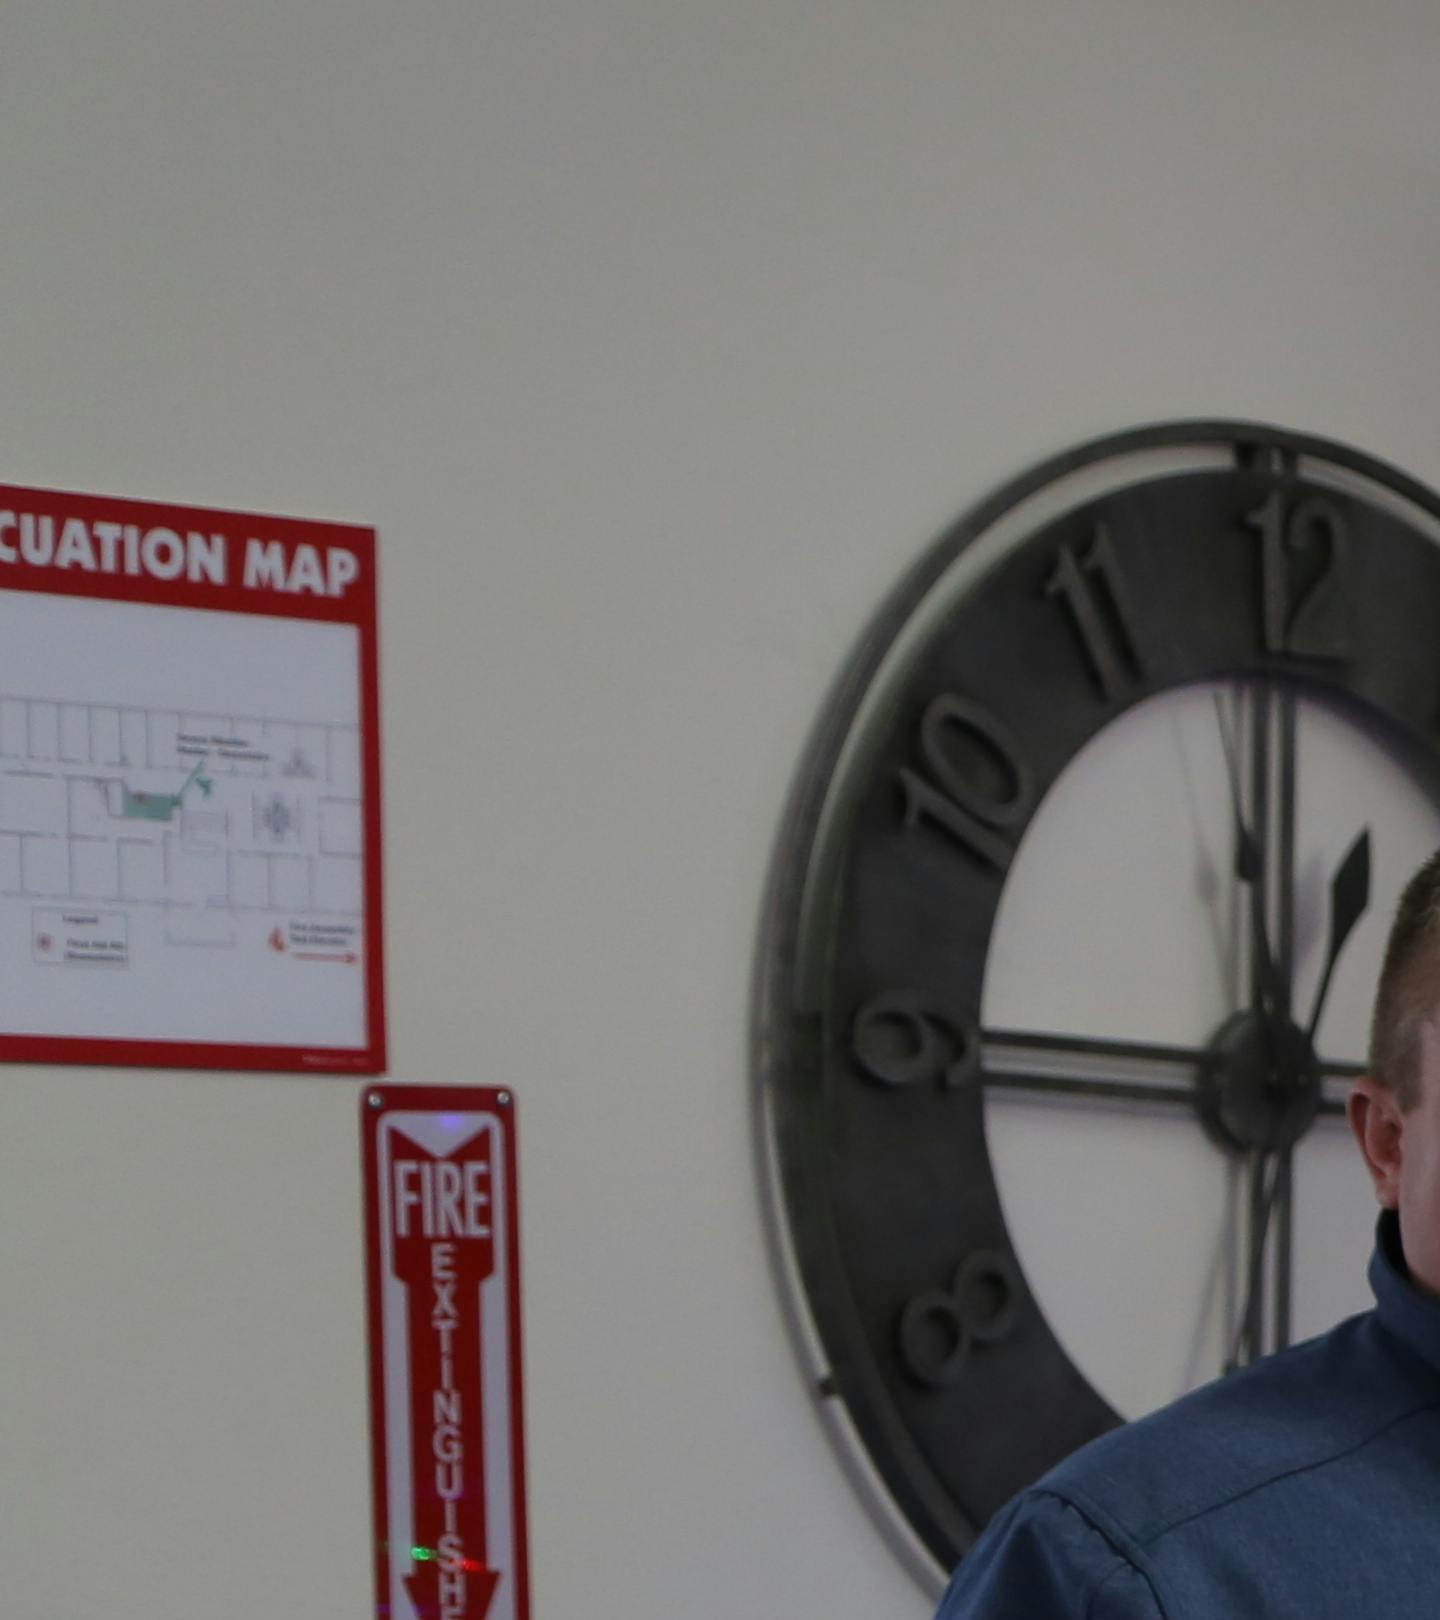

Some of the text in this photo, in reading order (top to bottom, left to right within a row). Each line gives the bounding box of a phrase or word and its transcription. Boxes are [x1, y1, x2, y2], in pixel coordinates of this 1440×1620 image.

[243, 538, 360, 597] MAP
[1046, 522, 1146, 698] 11
[1246, 494, 1352, 664] 12
[900, 694, 1034, 872] 10
[853, 992, 980, 1090] 9
[394, 1160, 491, 1238] FIRE
[900, 1250, 1012, 1388] 8
